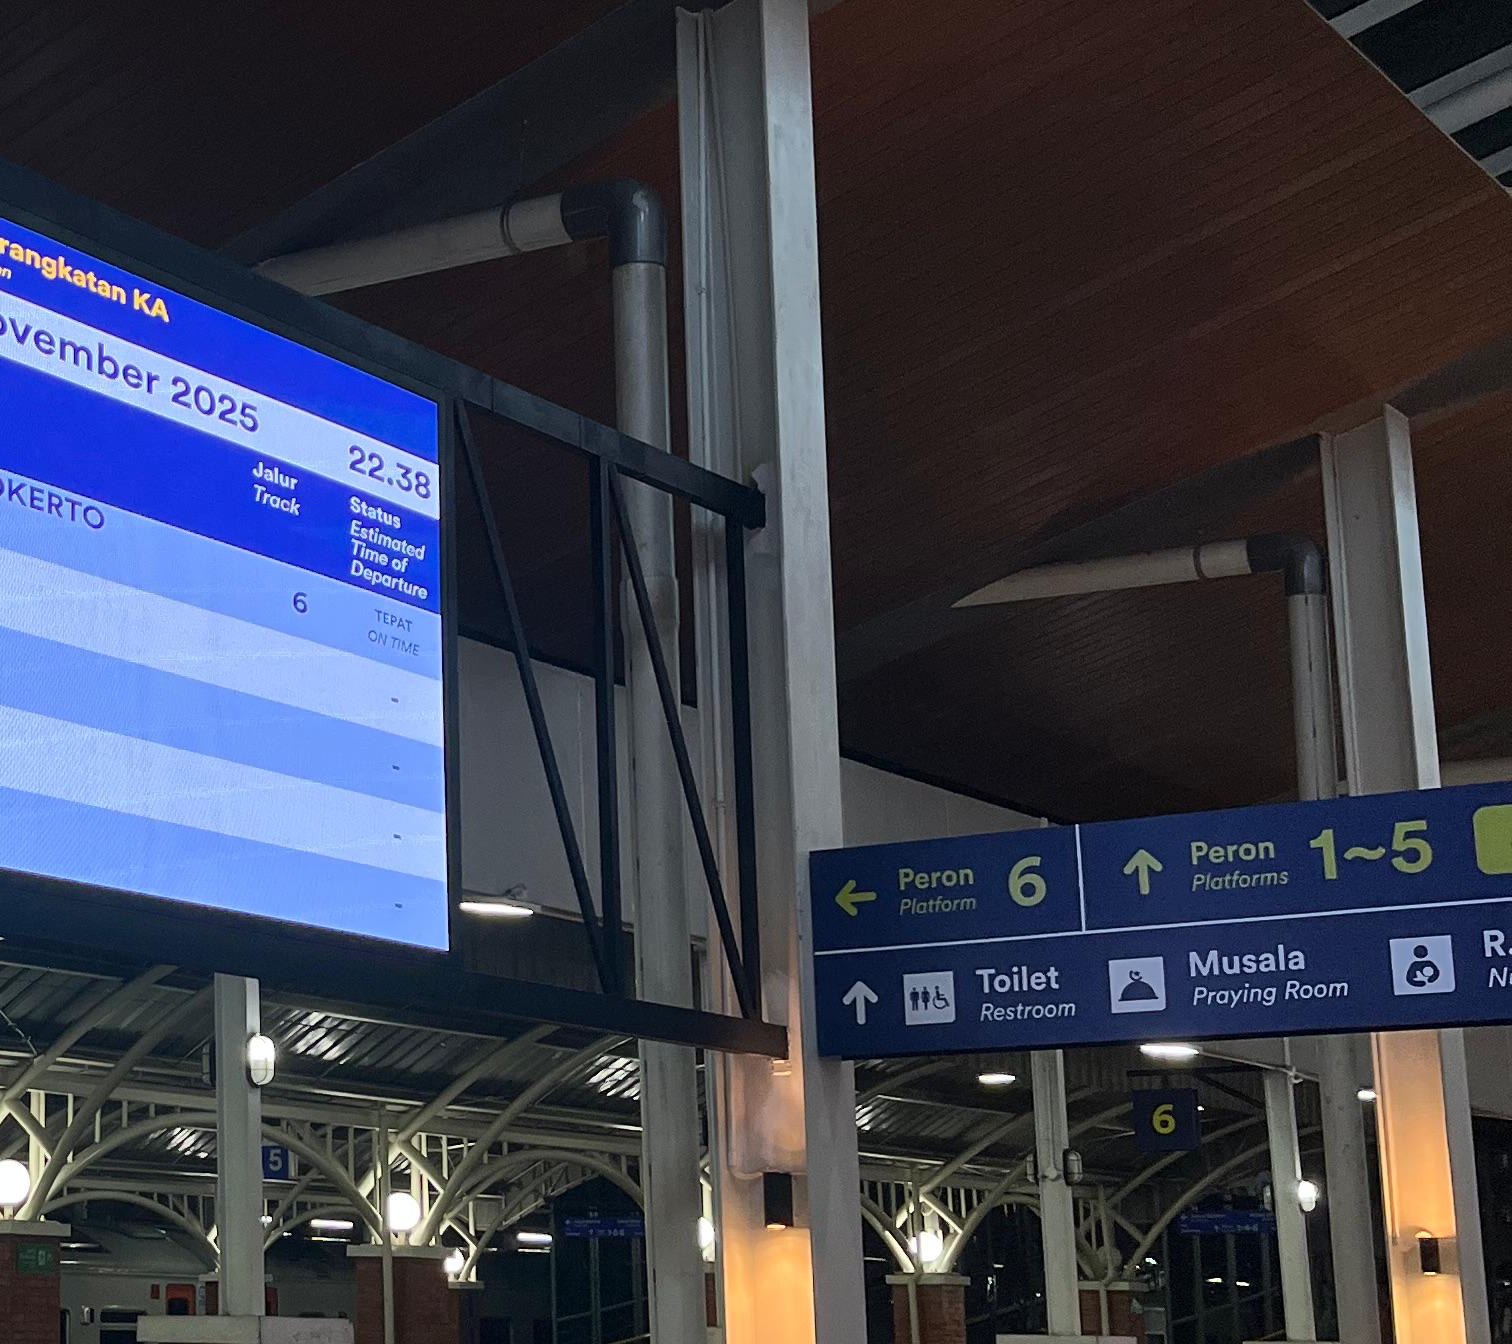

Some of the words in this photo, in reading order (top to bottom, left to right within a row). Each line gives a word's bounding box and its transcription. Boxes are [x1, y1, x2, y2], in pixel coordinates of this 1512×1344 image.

[133, 288, 170, 323] KA
[171, 375, 259, 433] 2025
[252, 462, 299, 490] Jalur
[349, 444, 431, 499] 22.38
[253, 484, 301, 516] Track
[349, 496, 402, 529] Status
[350, 520, 426, 560] Estimated
[351, 540, 389, 566] Time
[391, 558, 409, 573] of
[351, 560, 428, 600] Departure
[293, 592, 308, 613] 6
[374, 608, 413, 633] TEPAT
[367, 630, 387, 646] ON
[390, 636, 420, 656] TIME
[1190, 840, 1276, 865] Peron
[1309, 820, 1433, 881] 1~5
[898, 868, 974, 891] Peron
[1008, 856, 1047, 907] 6
[1191, 871, 1289, 892] Platforms
[899, 896, 977, 916] Platform
[1189, 944, 1306, 977] Musala
[975, 966, 1060, 994] Toilet
[1488, 967, 1512, 988] N
[1193, 983, 1277, 1009] Praying
[1284, 980, 1349, 1000] Room
[980, 1003, 1076, 1022] Restroom
[1152, 1103, 1176, 1135] 6
[269, 1149, 283, 1172] 5
